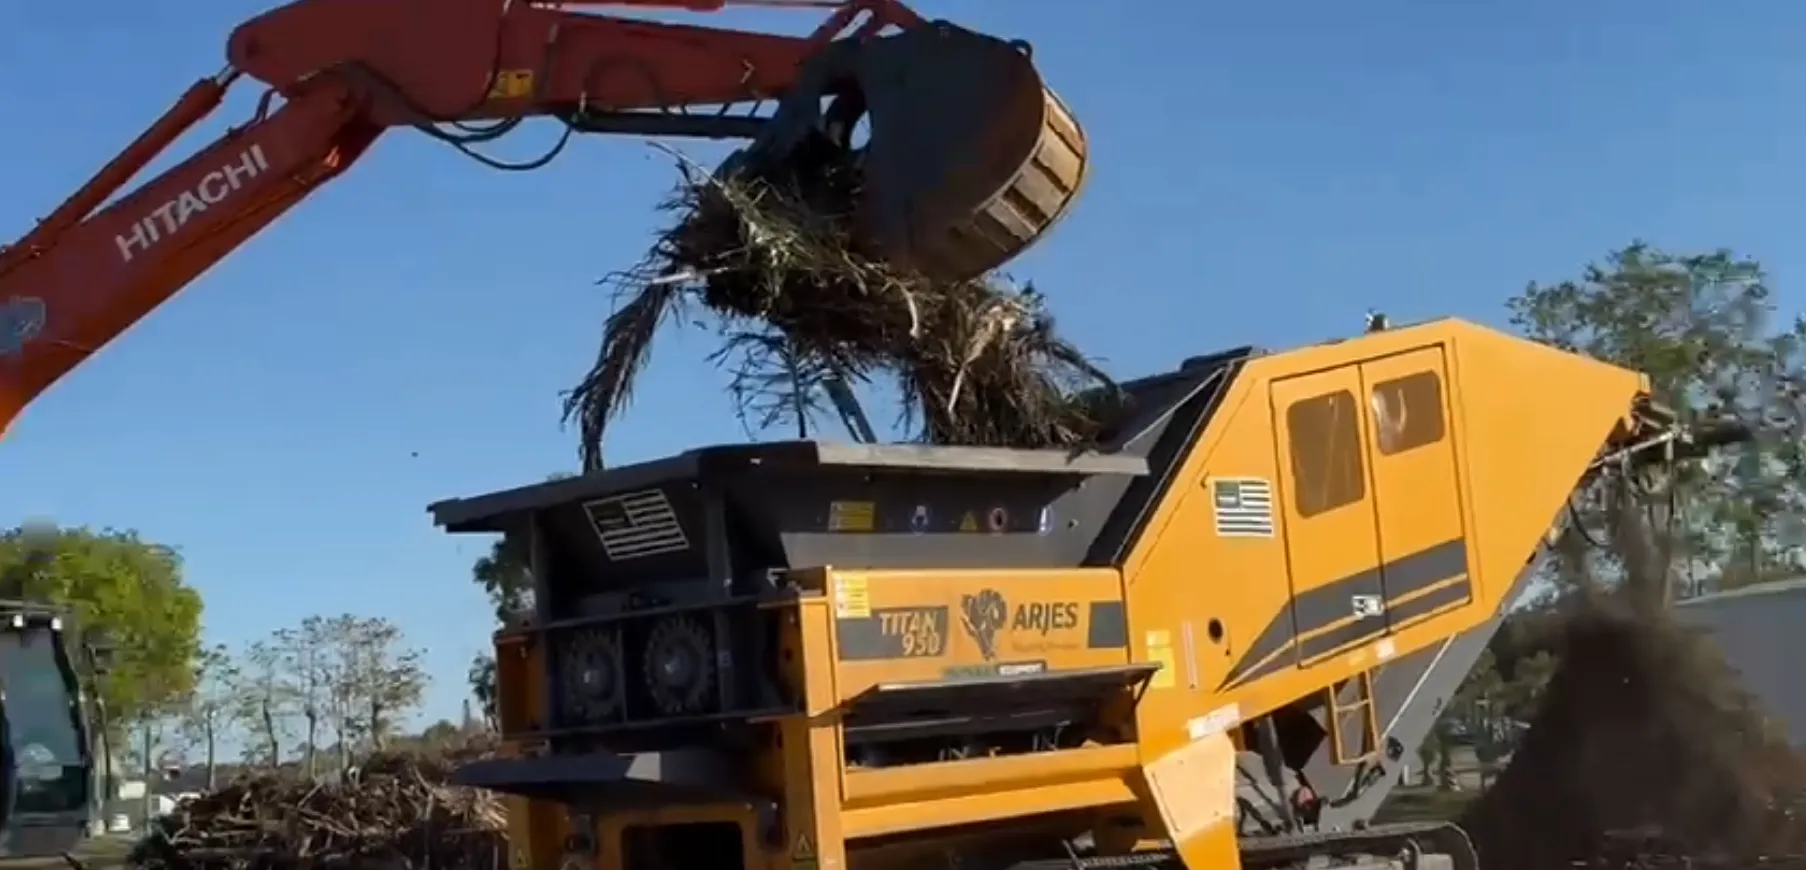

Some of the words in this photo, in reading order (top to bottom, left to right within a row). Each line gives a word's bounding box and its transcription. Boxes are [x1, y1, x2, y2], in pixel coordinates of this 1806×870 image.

[114, 143, 269, 262] HITACHI
[879, 611, 938, 635] TITAN
[1012, 603, 1079, 635] ARJES
[902, 632, 941, 656] 950
